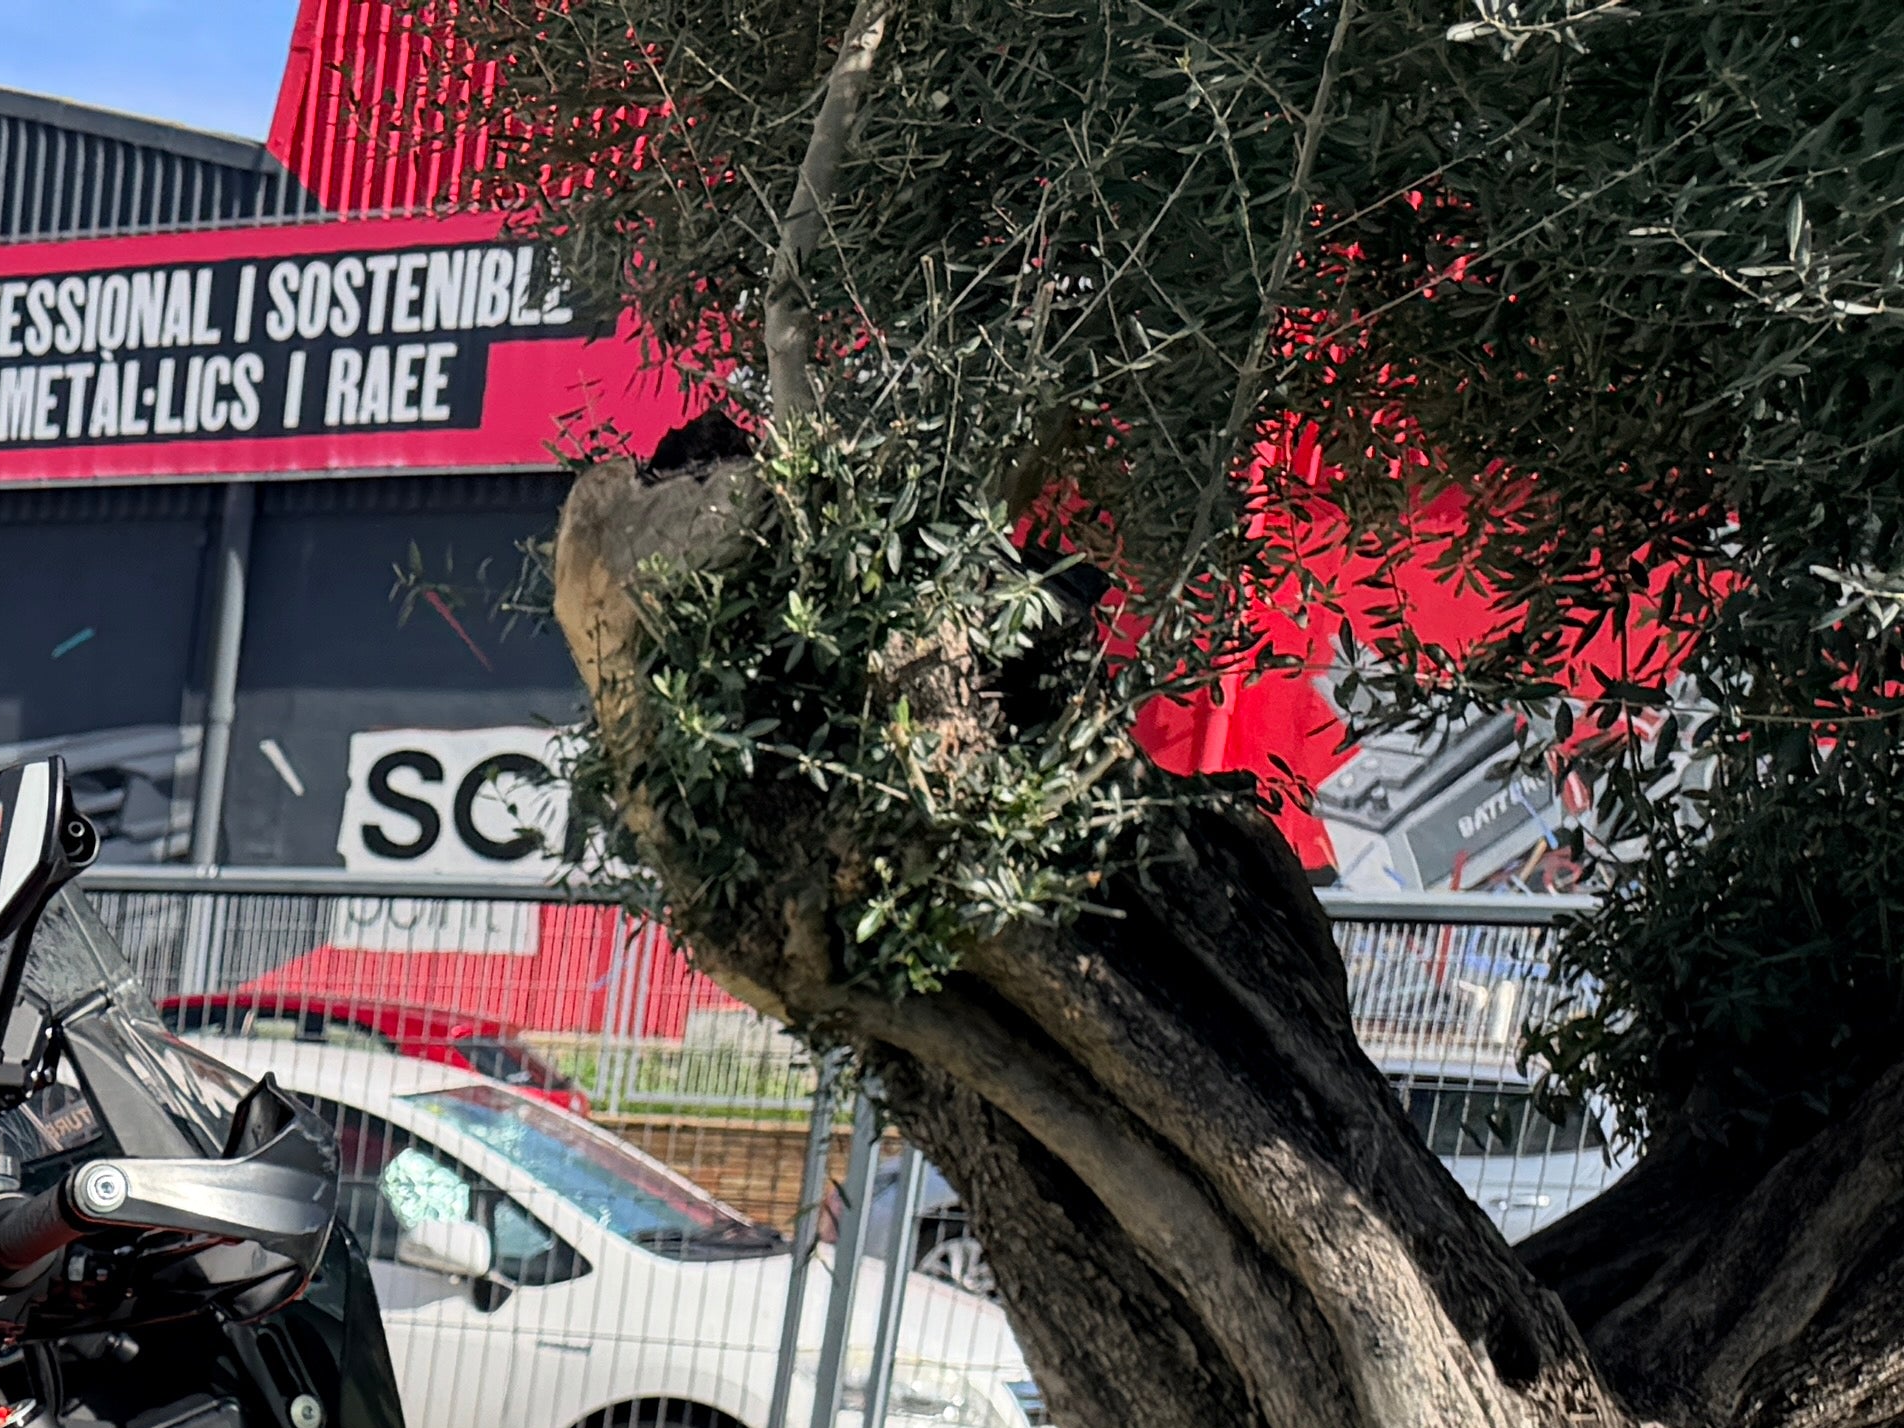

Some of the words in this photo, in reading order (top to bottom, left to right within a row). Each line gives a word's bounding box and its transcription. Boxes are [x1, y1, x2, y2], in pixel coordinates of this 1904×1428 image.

[234, 265, 257, 343] I
[283, 355, 306, 428] I
[324, 342, 458, 426] RAEE
